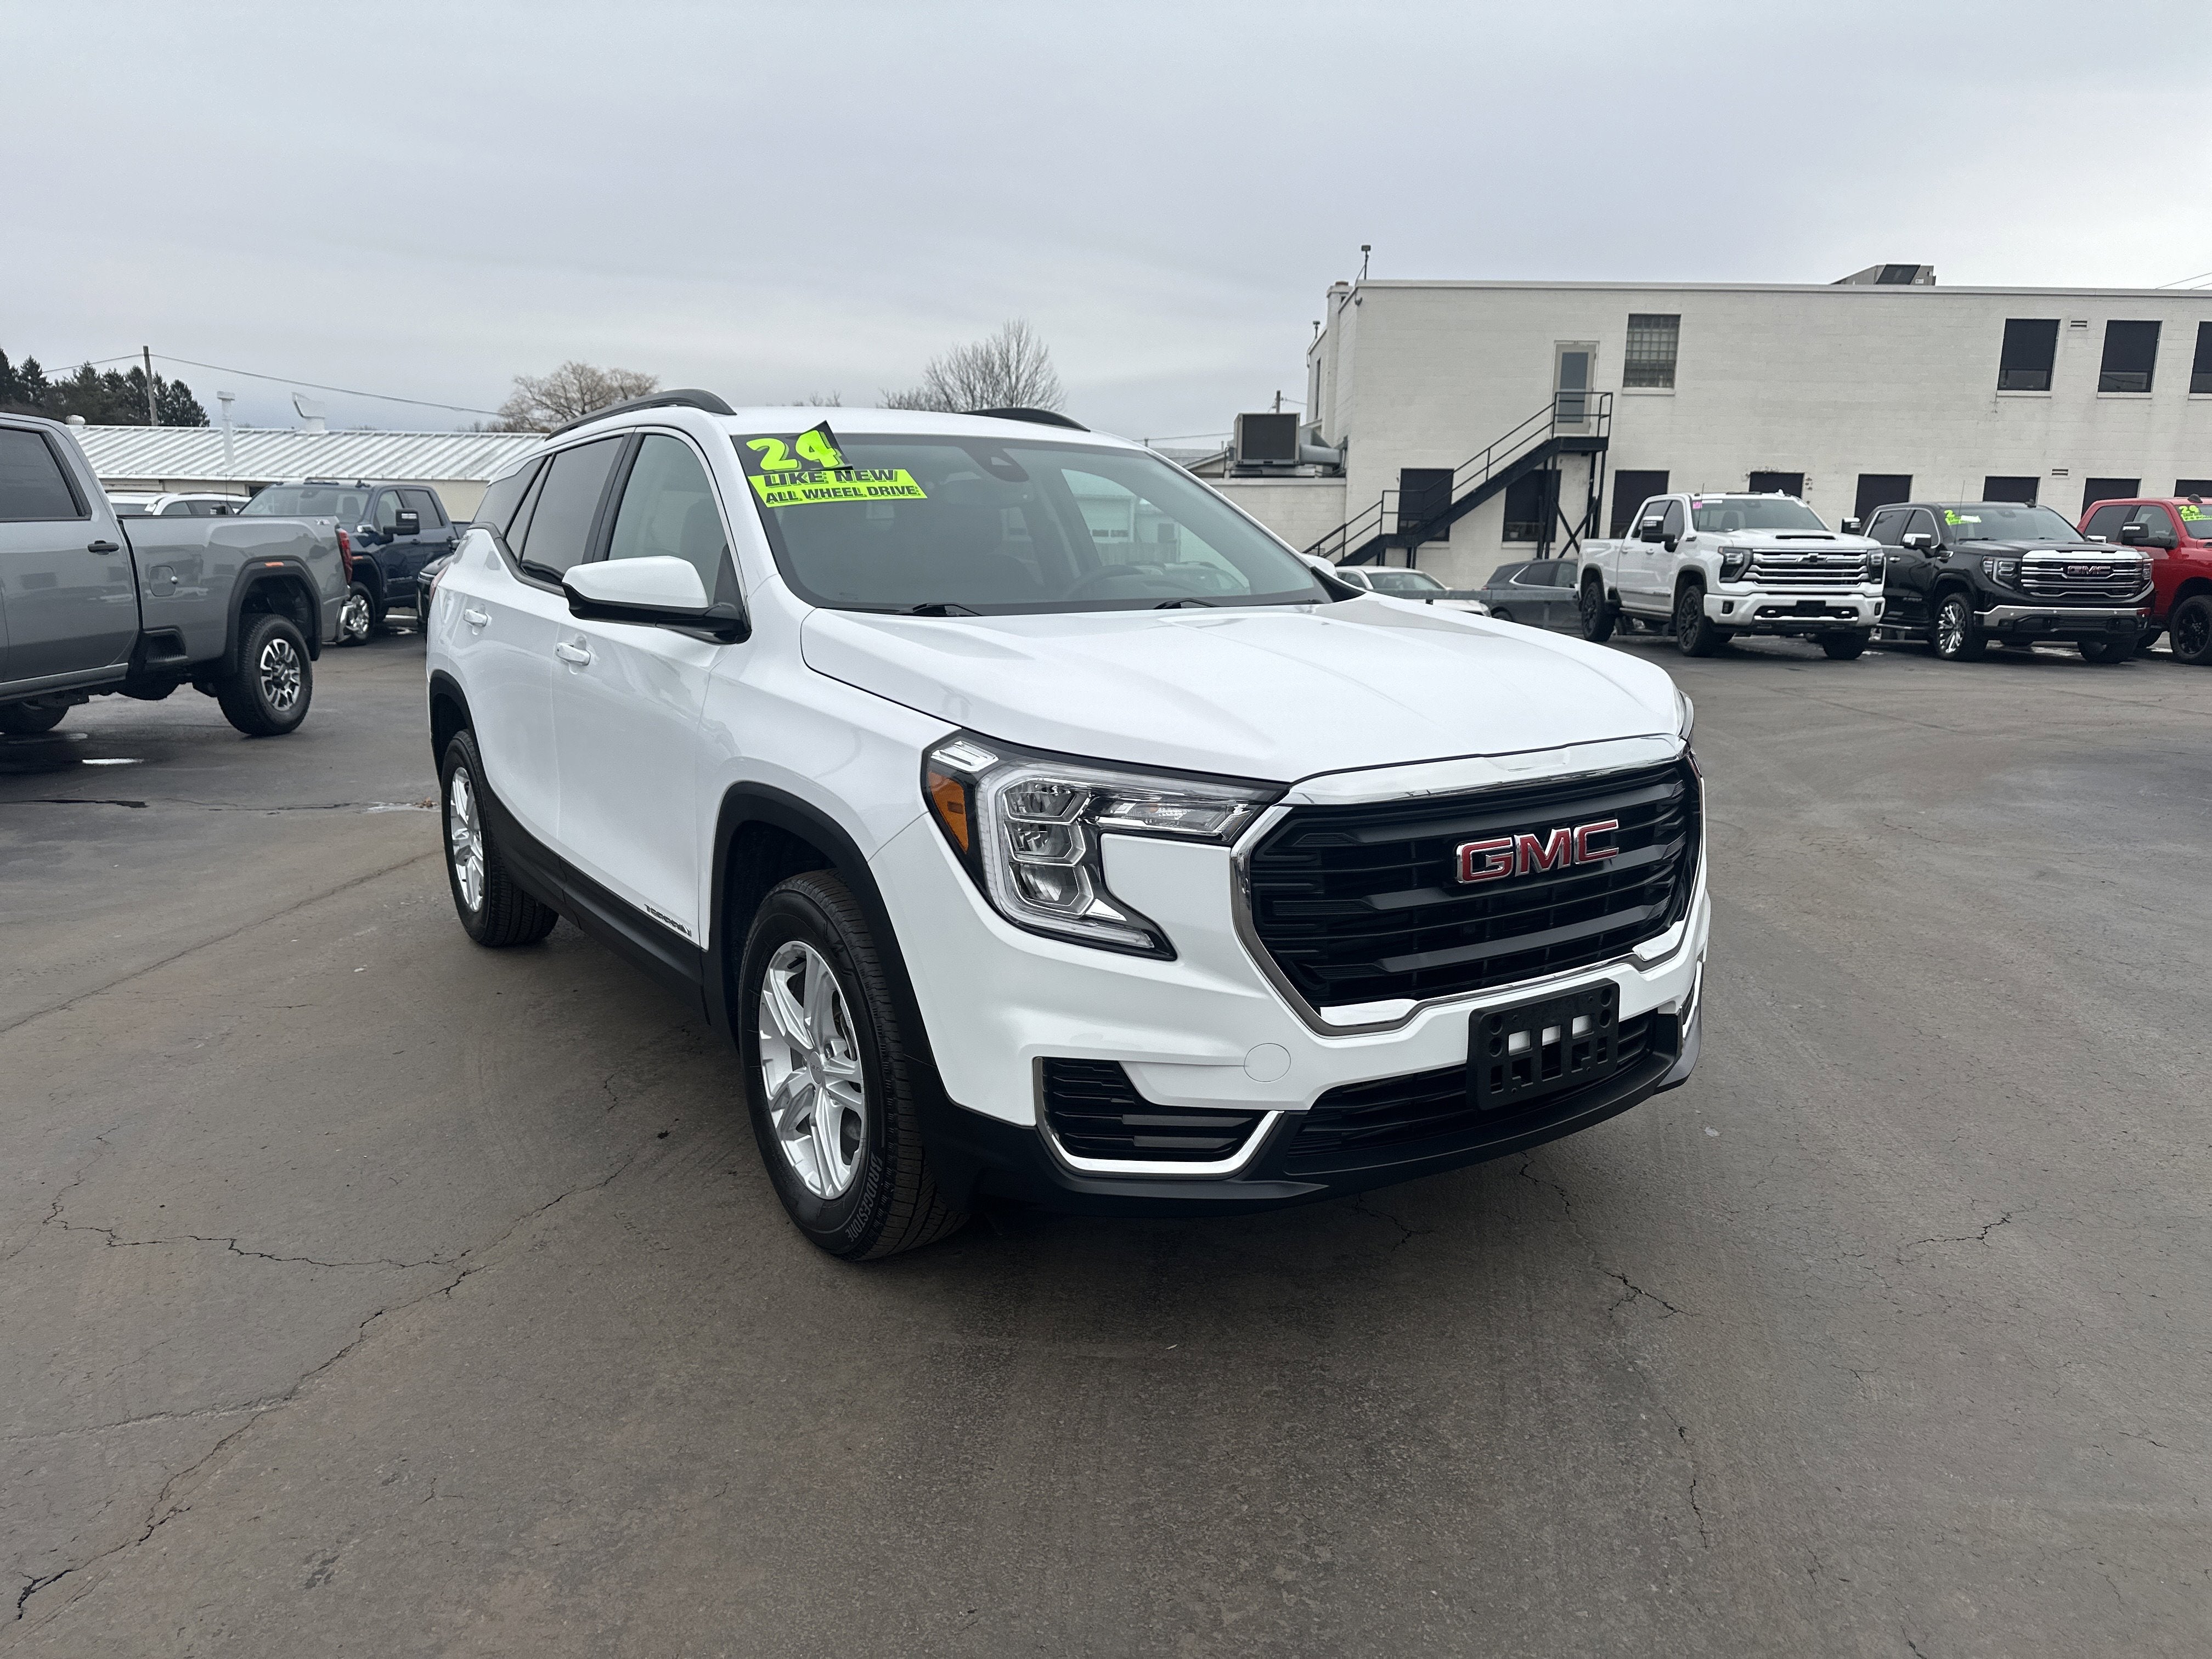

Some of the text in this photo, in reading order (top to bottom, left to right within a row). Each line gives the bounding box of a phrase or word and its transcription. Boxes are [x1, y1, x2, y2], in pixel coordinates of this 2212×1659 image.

[746, 430, 845, 470] 24
[764, 469, 898, 487] LIKE NEW
[766, 485, 921, 504] ALL WHEEL DRIVE
[2067, 564, 2111, 574] GMC
[1455, 819, 1620, 885] GMC
[845, 1152, 883, 1243] BRIDGESTONE
